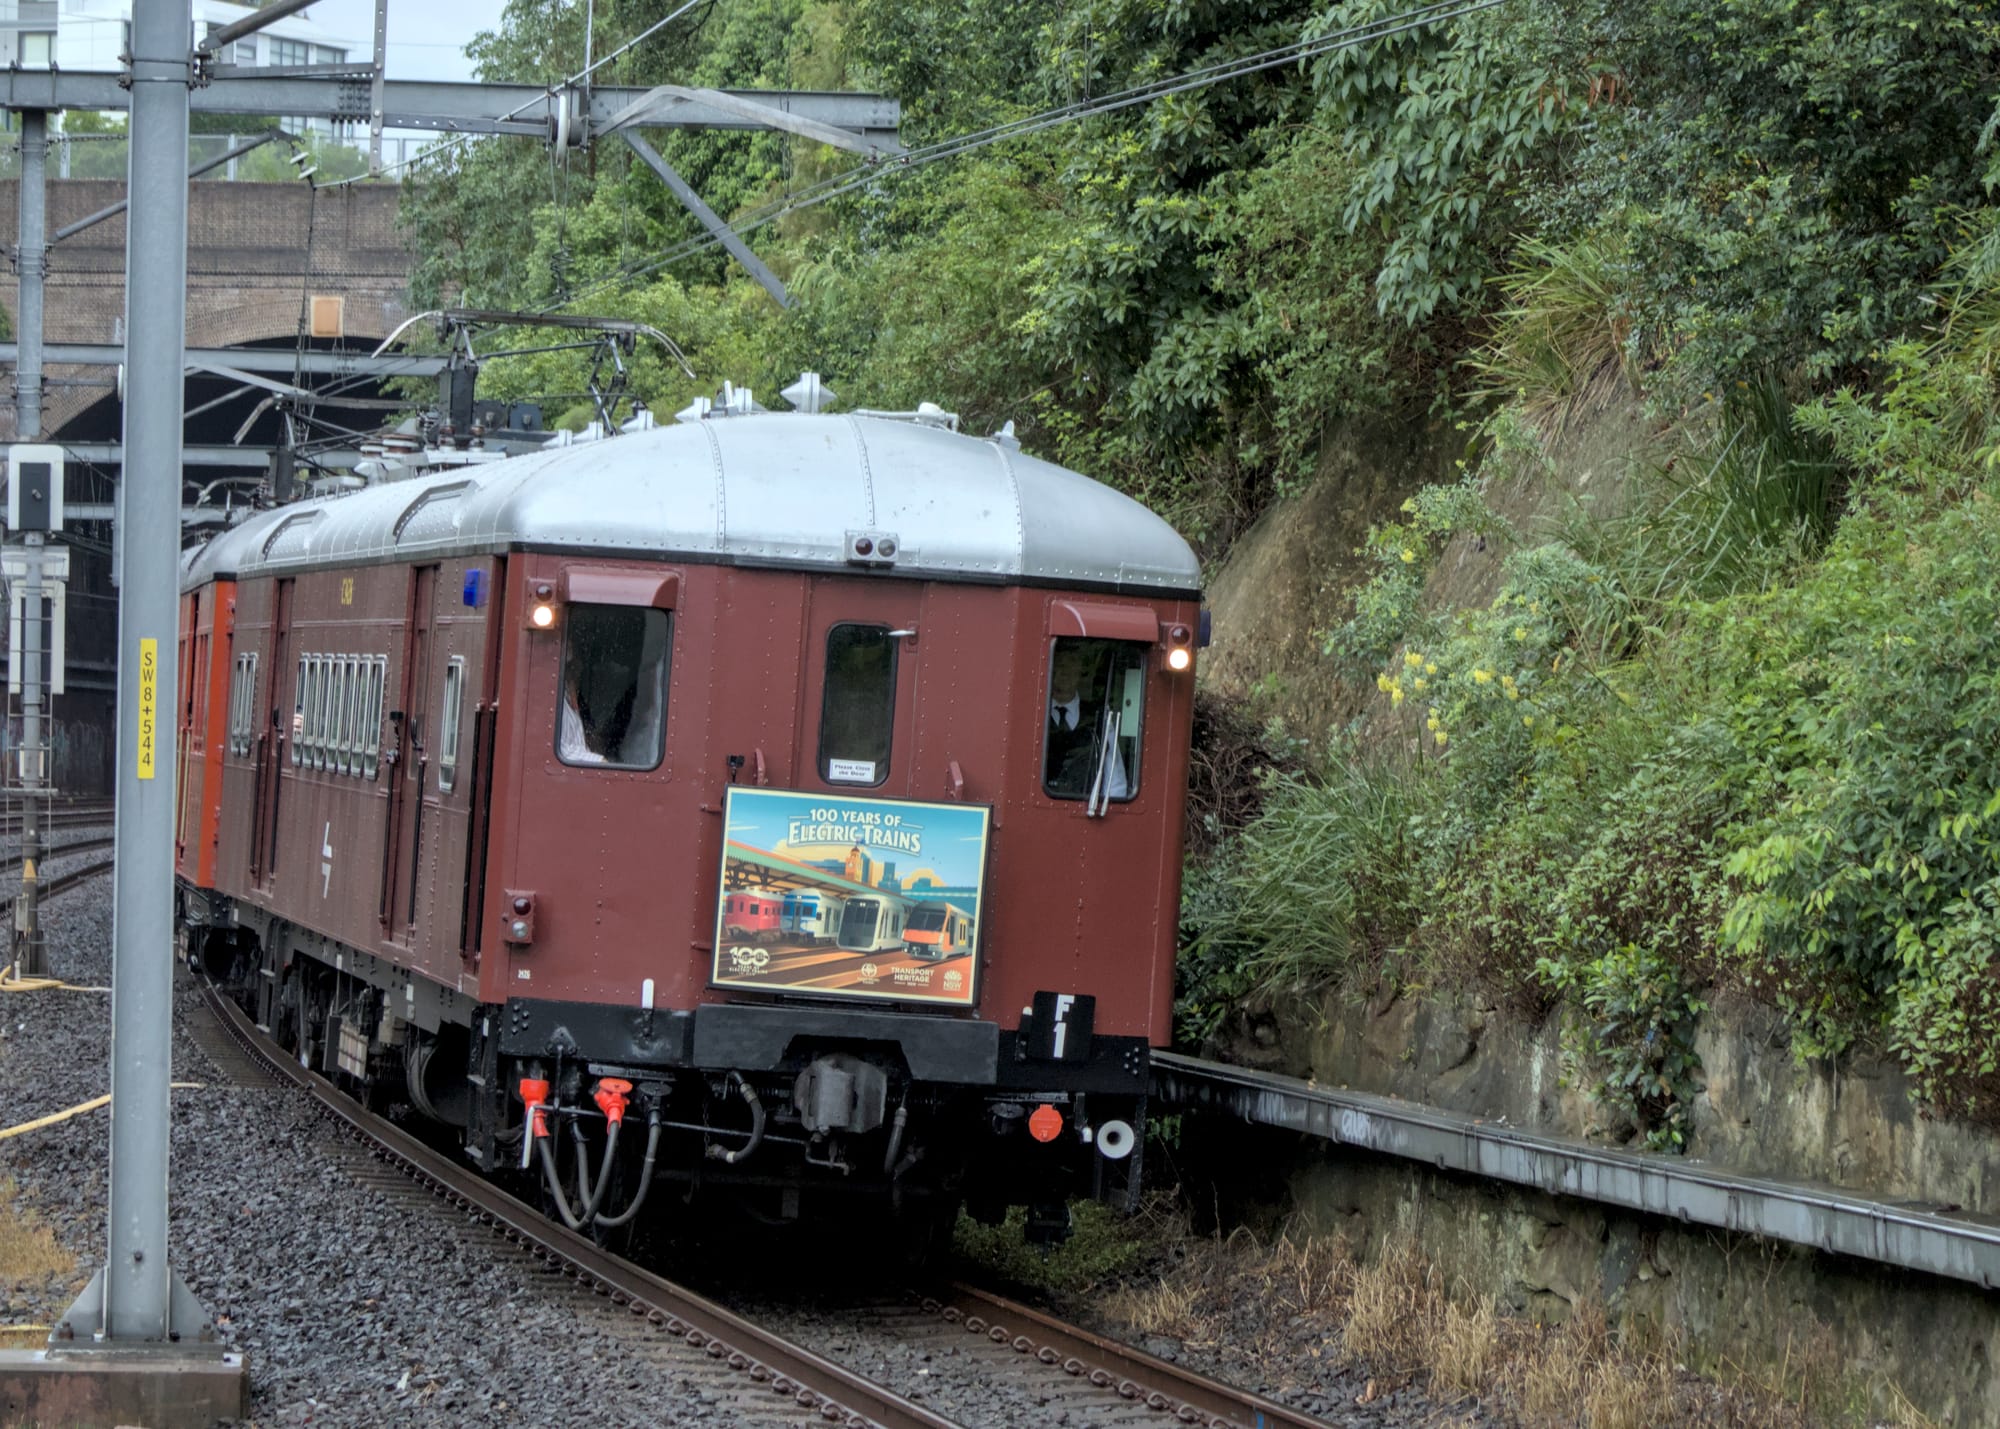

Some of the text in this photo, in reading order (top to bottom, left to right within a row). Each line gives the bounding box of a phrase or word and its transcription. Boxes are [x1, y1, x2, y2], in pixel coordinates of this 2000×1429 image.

[809, 808, 902, 827] 100 YEARS OF
[890, 966, 935, 977] TRANSPORT
[894, 974, 930, 984] HERITAGE
[1055, 994, 1075, 1021] F
[1053, 1022, 1067, 1058] 1
